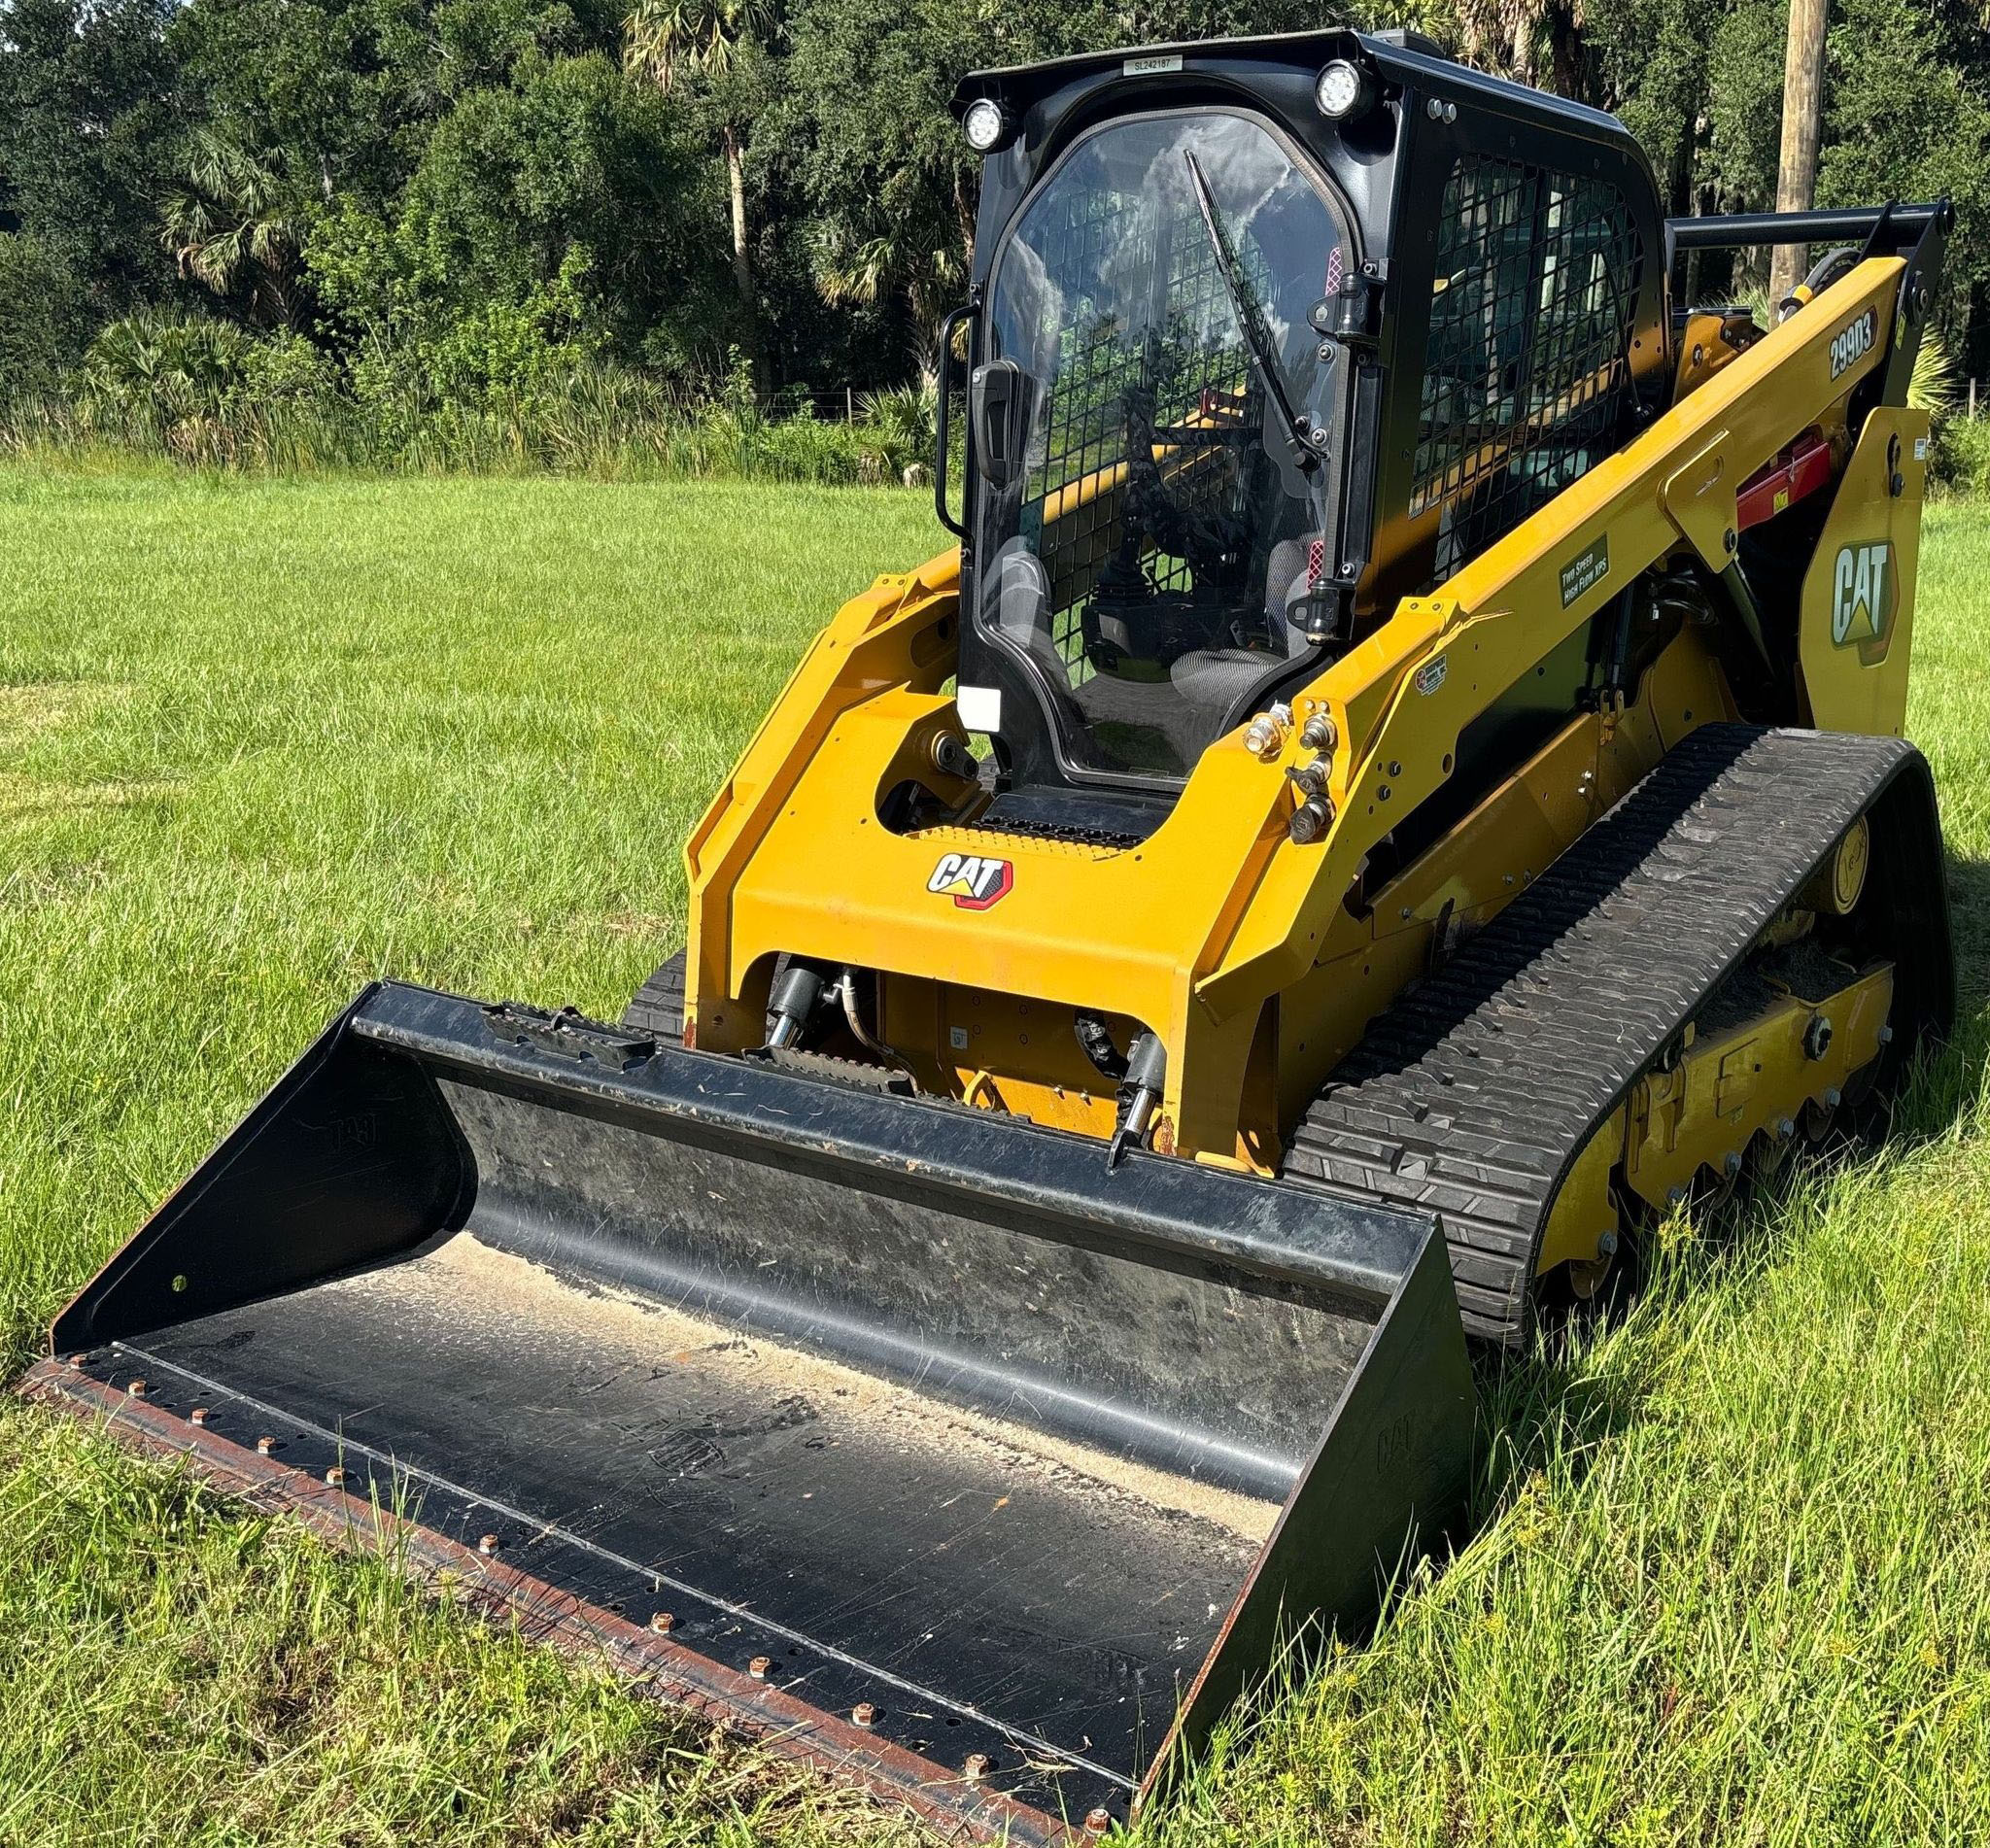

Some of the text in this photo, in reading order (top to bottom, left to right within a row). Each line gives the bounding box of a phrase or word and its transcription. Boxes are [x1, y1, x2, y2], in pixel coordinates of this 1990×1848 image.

[1135, 59, 1171, 70] SL242187
[1830, 312, 1871, 380] 299D3
[1595, 557, 1606, 577] XPS
[1833, 544, 1888, 643] CAT
[927, 853, 1005, 899] CAT
